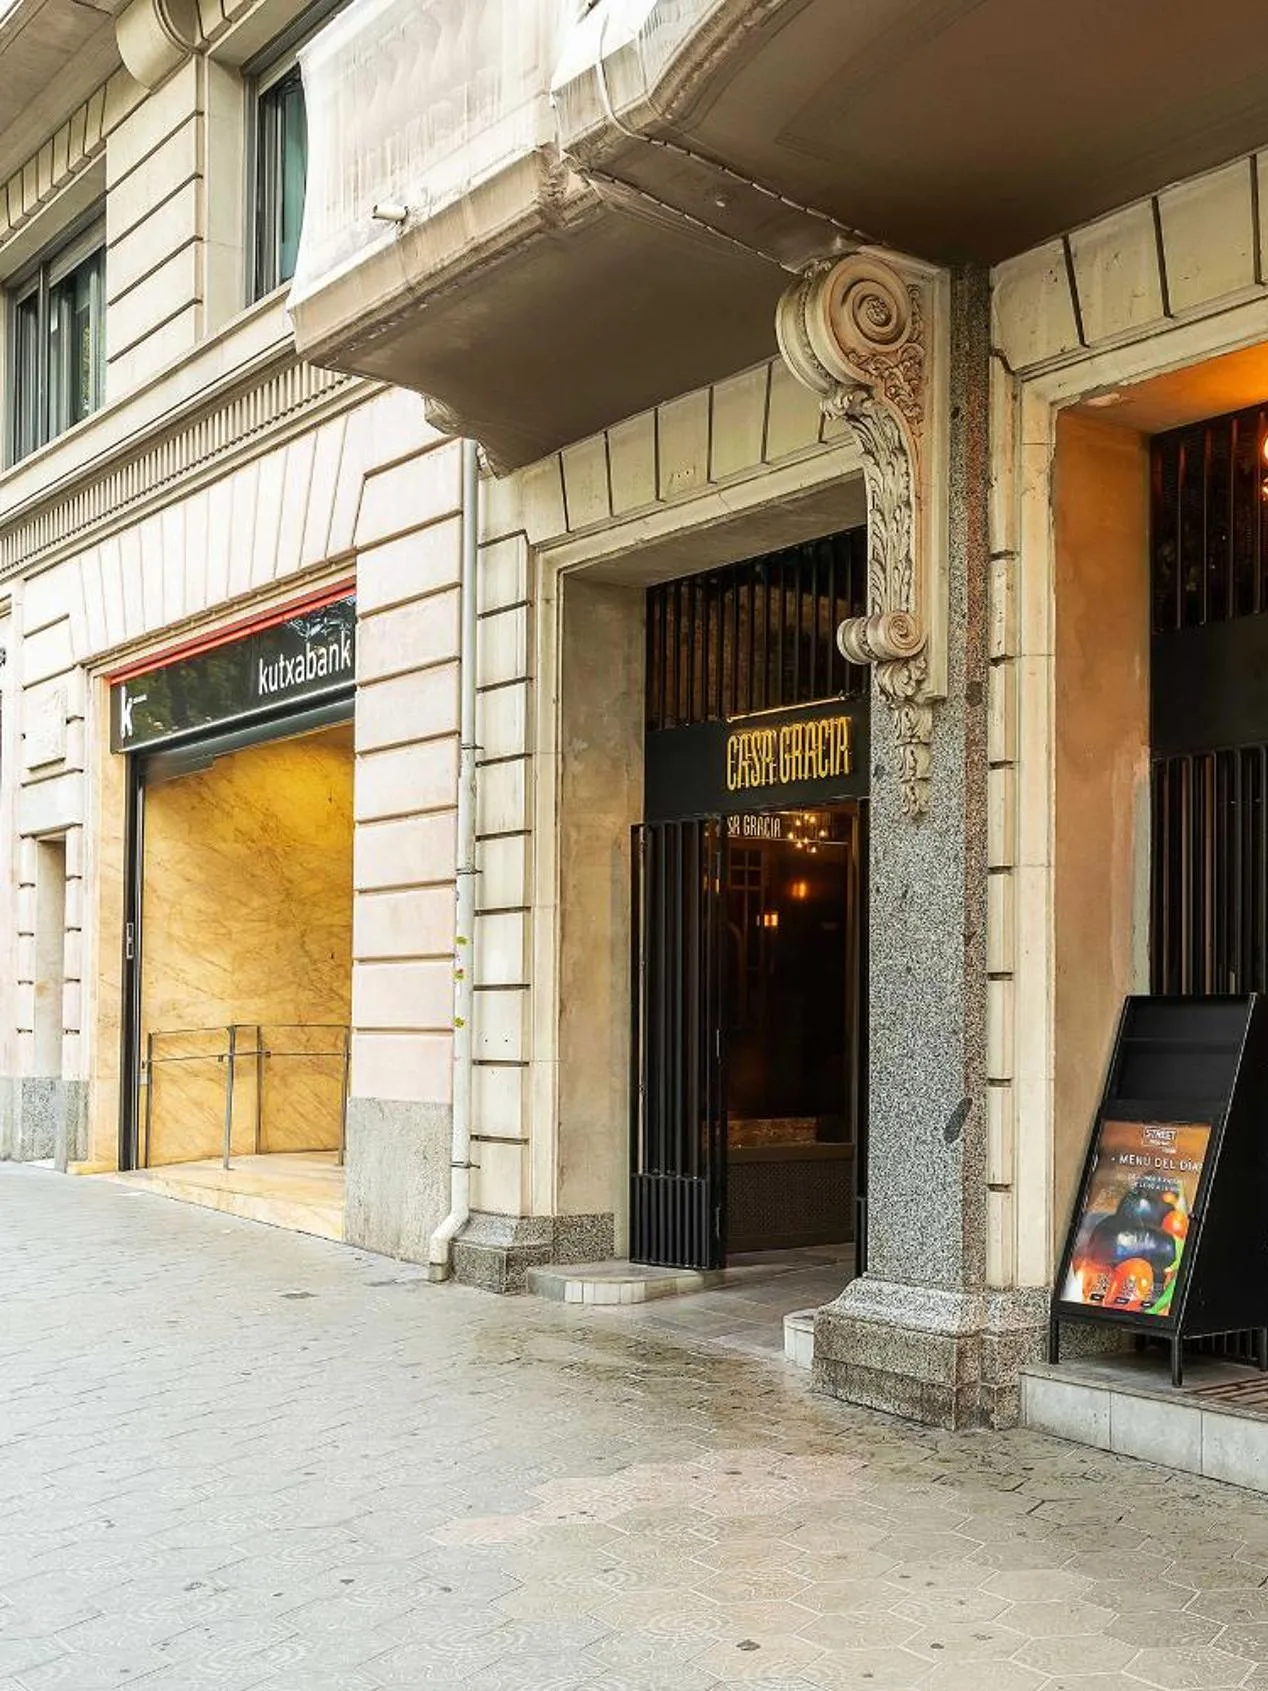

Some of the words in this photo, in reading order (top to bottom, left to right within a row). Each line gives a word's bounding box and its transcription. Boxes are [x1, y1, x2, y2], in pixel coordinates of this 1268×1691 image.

[258, 631, 352, 695] kutxabank
[726, 729, 776, 791] CASA
[779, 716, 851, 784] GRACIA
[726, 814, 740, 835] SA
[743, 814, 781, 838] GRACIA
[1154, 1157, 1176, 1170] DEL
